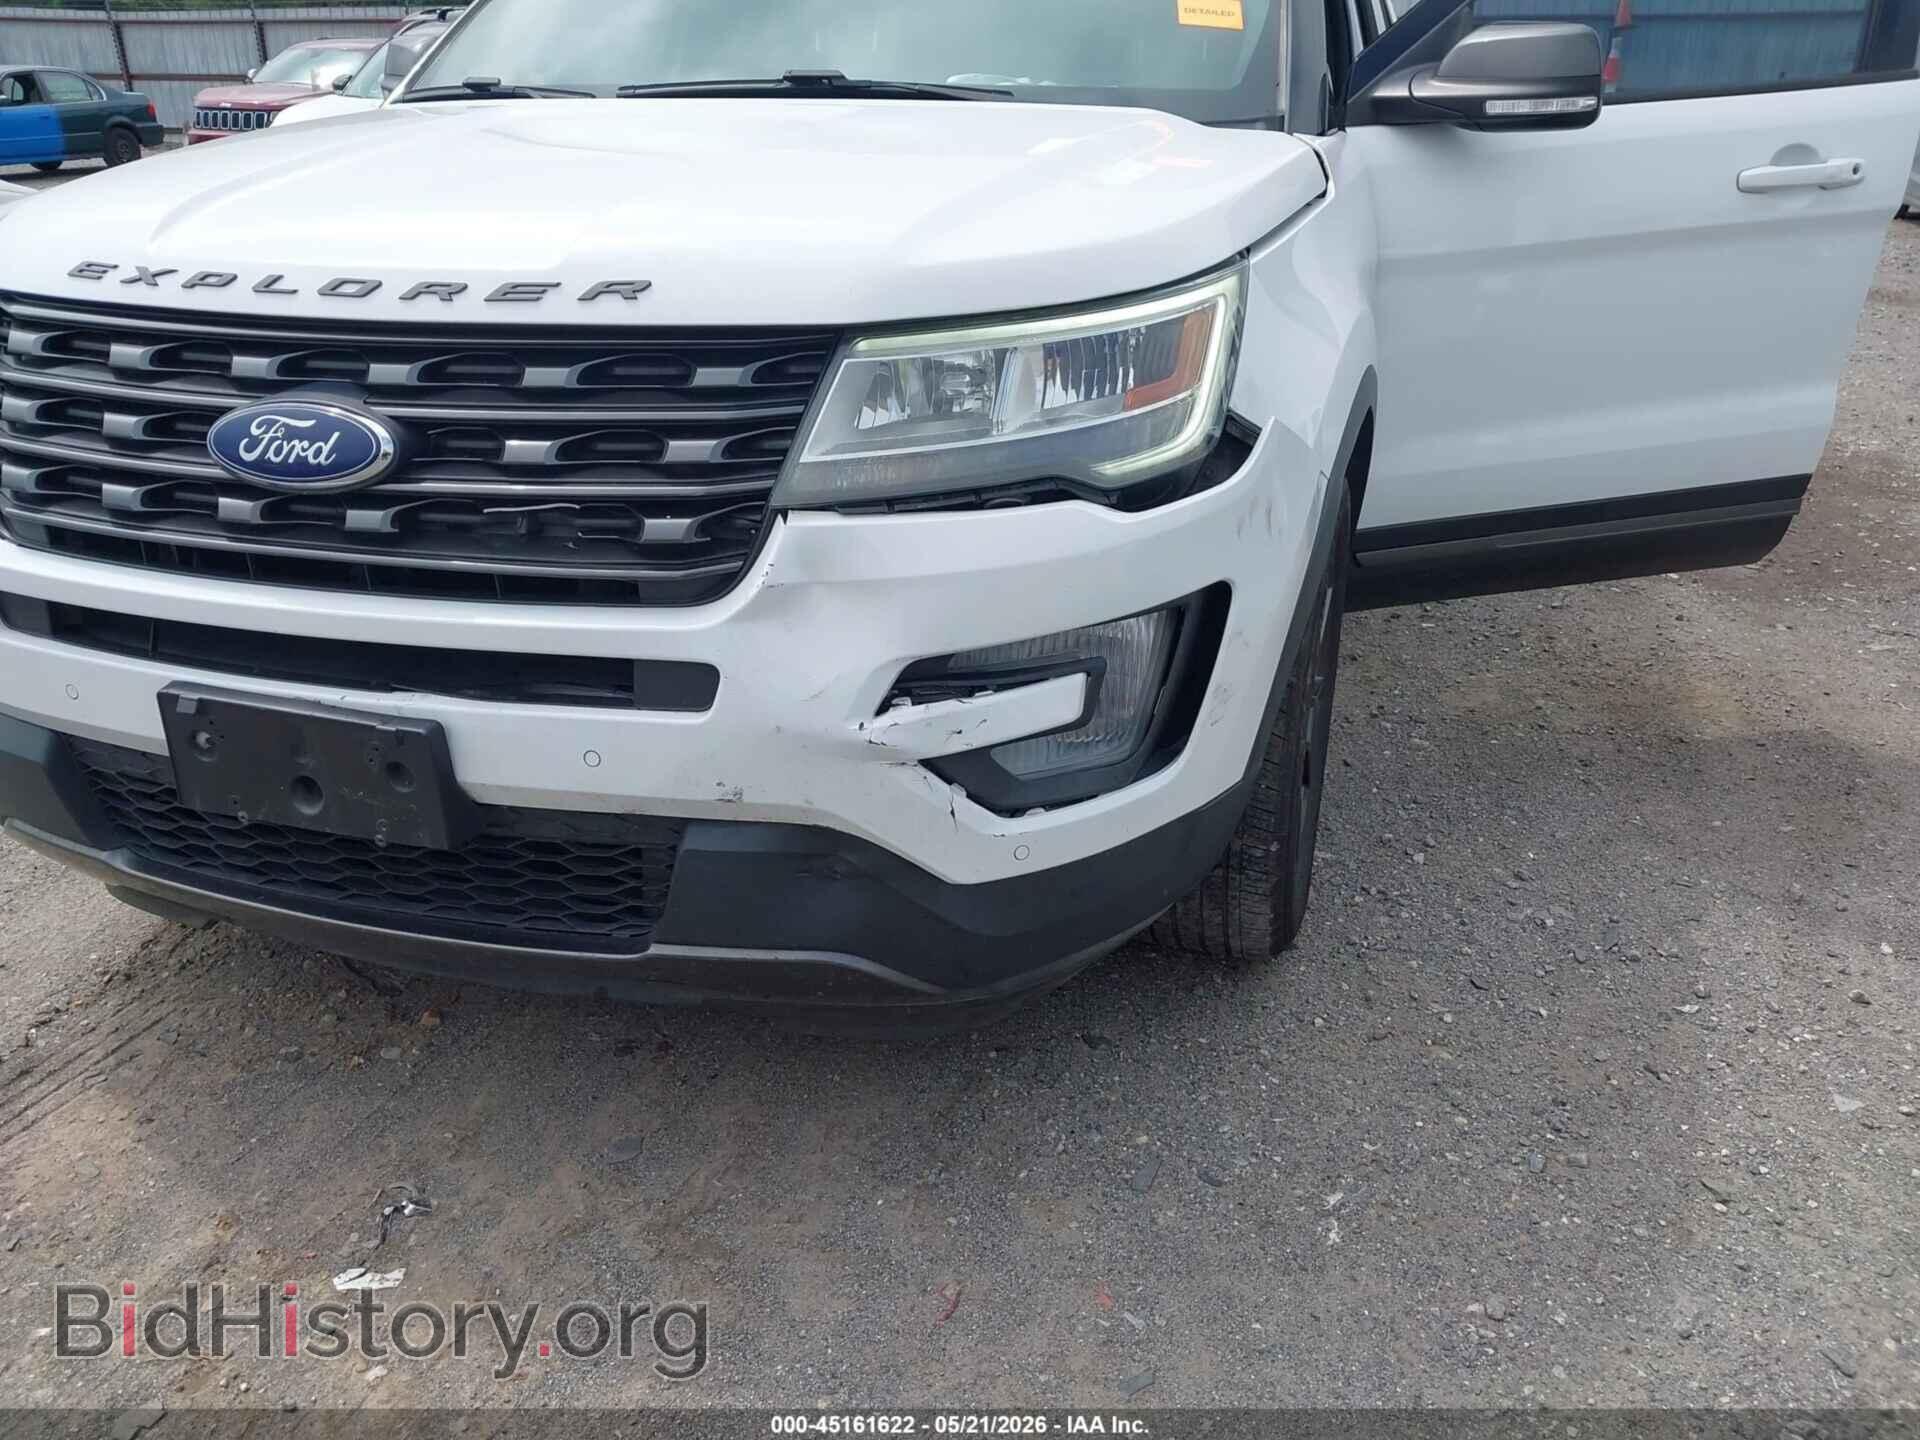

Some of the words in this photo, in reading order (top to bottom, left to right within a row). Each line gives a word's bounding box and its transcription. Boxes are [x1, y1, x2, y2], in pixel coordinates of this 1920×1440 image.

[1183, 7, 1236, 16] DETAILED
[67, 259, 652, 303] EXPLORER
[238, 414, 341, 469] Ford
